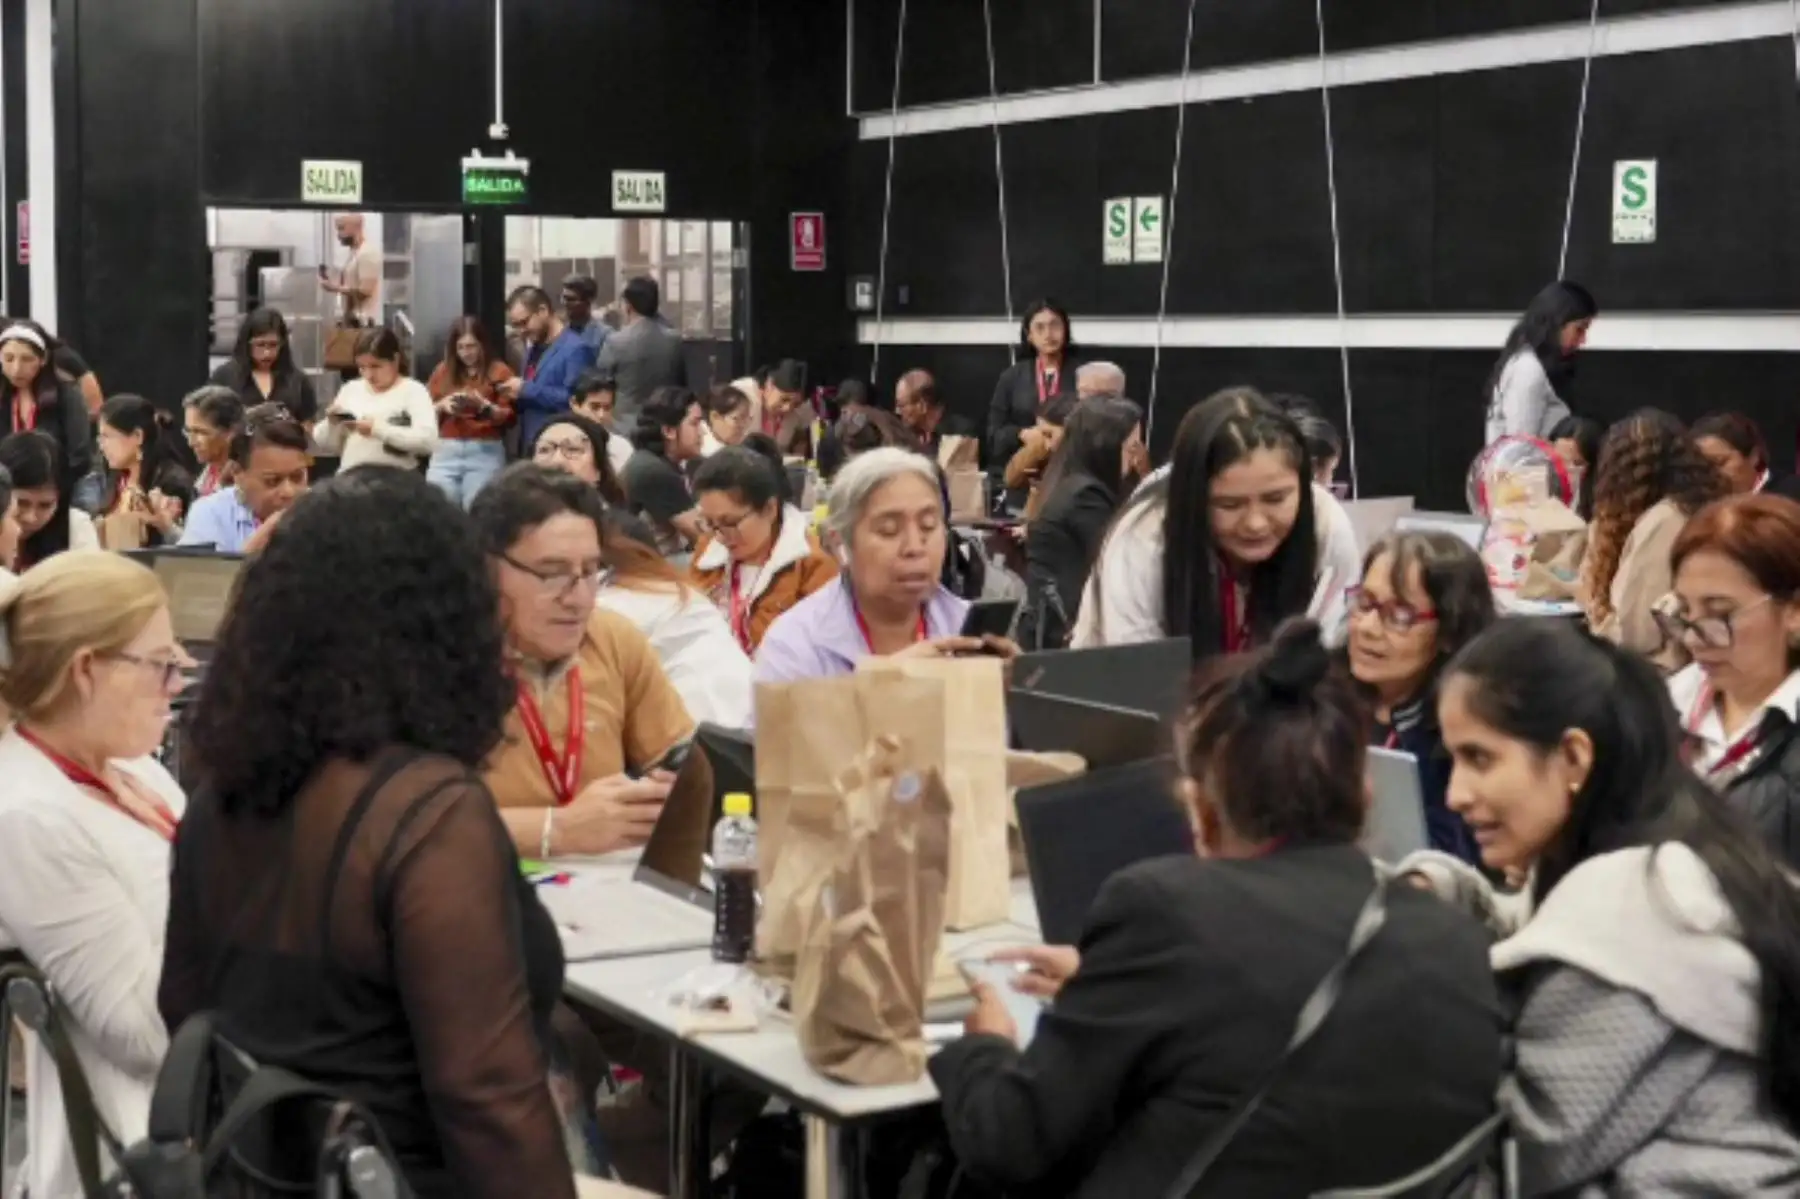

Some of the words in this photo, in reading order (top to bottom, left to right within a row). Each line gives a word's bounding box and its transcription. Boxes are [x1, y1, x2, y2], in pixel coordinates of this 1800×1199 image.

[307, 168, 357, 195] SALIDA
[466, 177, 525, 192] SALIDA
[1622, 166, 1647, 210] S
[1109, 203, 1126, 238] S
